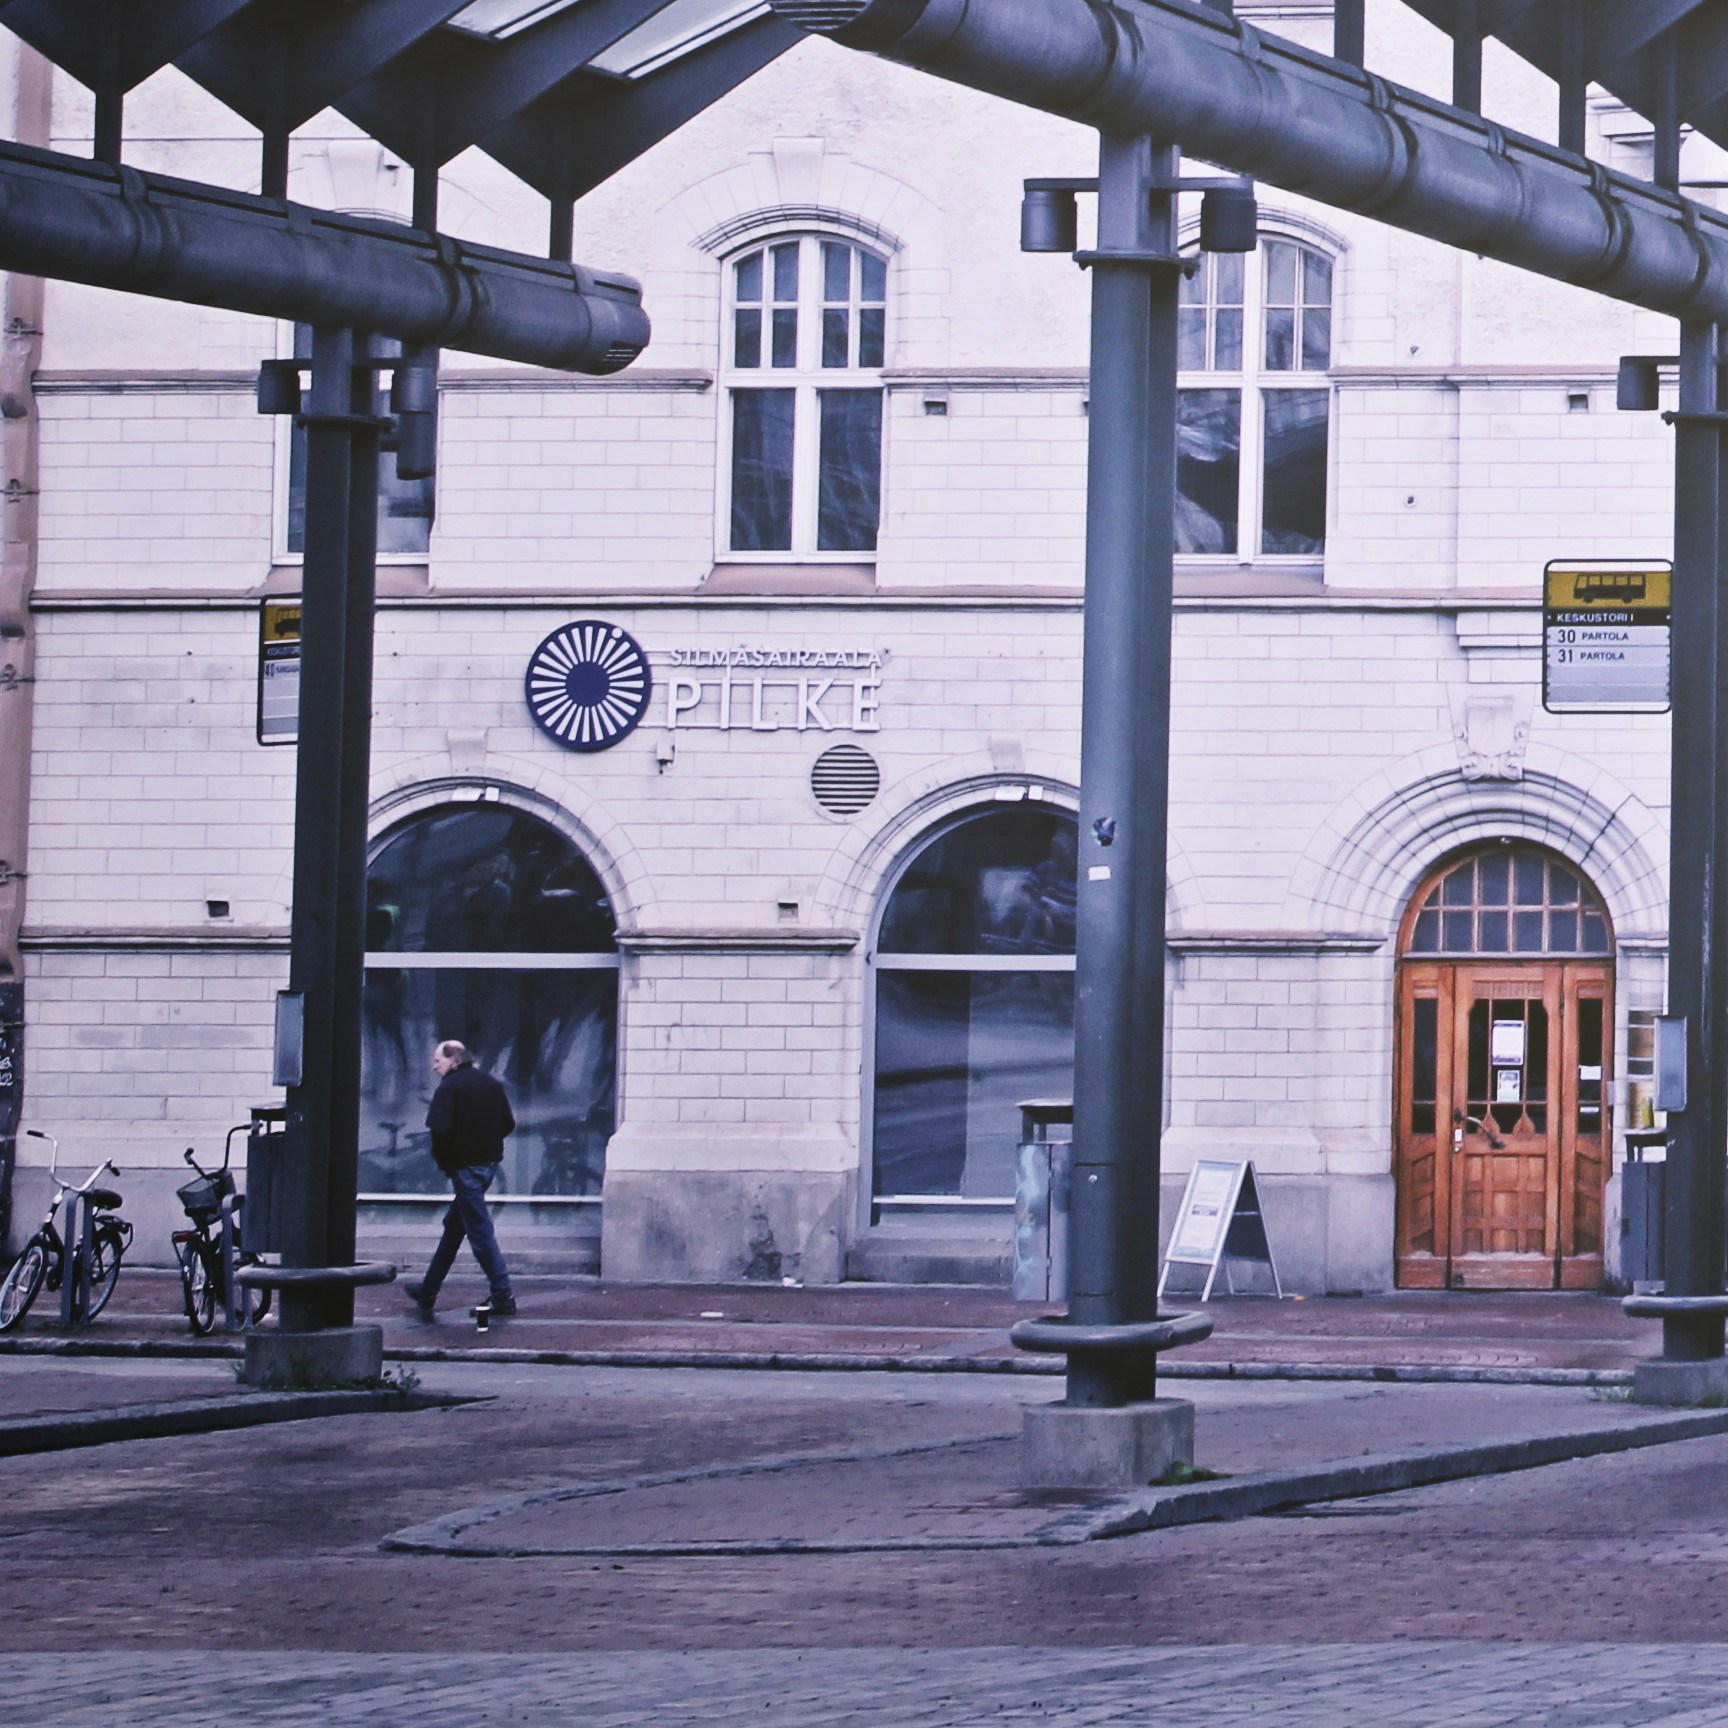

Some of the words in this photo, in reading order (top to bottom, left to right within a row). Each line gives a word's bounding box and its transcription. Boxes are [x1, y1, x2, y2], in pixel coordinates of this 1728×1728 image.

[1556, 613, 1627, 623] KESKUSTORI
[1557, 629, 1576, 644] 30
[1581, 631, 1629, 641] PARTOLA
[669, 645, 882, 668] SILMÄSAIRAALA
[1557, 648, 1573, 663] 31
[1580, 651, 1625, 661] PARTOLA
[666, 675, 883, 733] PILKE
